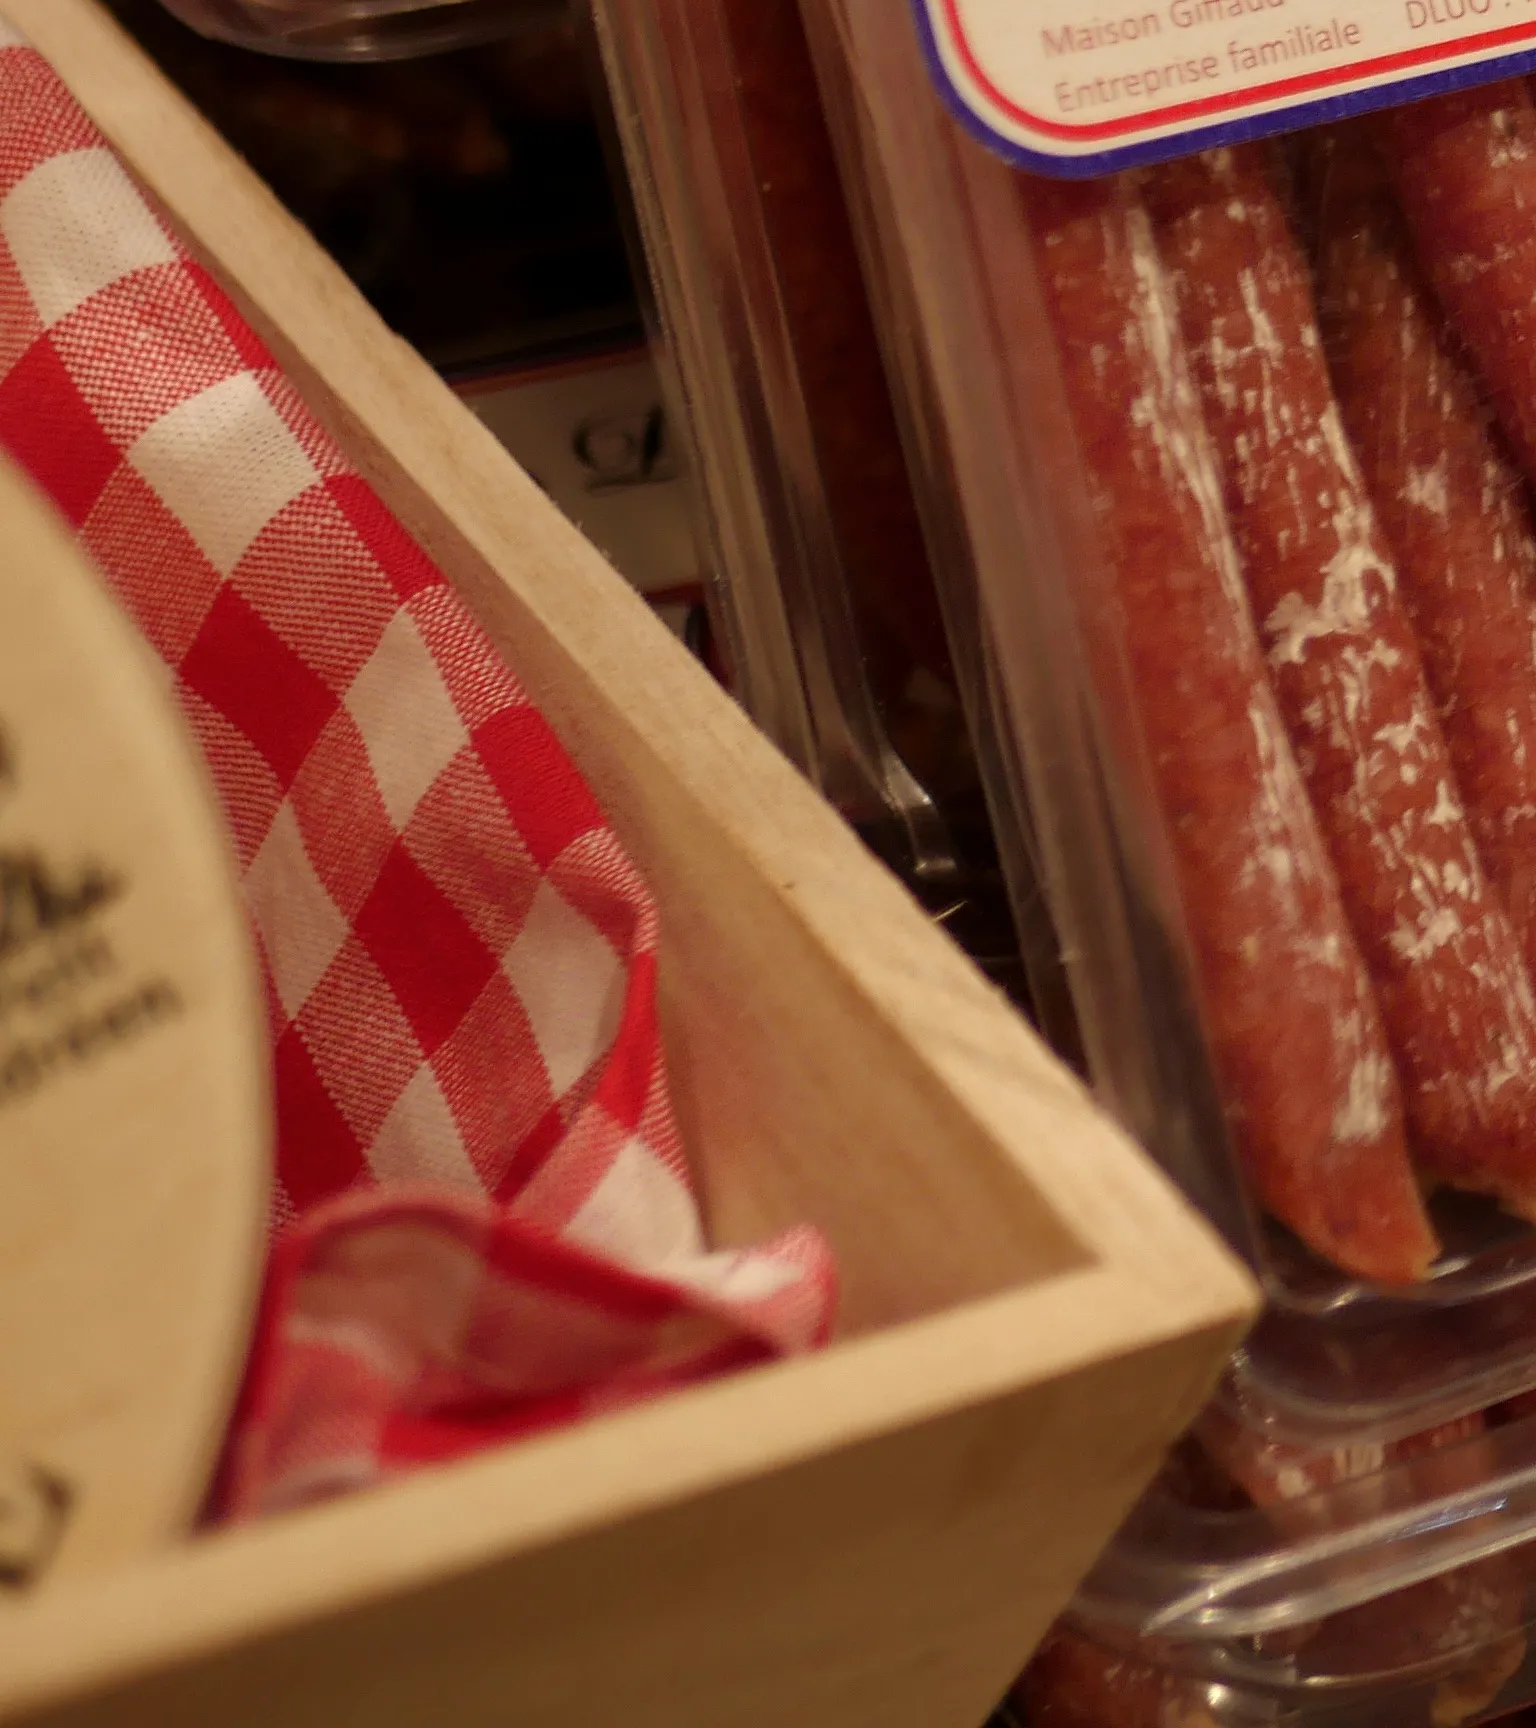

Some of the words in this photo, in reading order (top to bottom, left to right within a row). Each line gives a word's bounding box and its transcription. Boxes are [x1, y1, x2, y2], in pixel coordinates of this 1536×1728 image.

[1041, 10, 1162, 59] Maison
[1054, 50, 1220, 113] Entreprise
[1227, 18, 1362, 74] familiale
